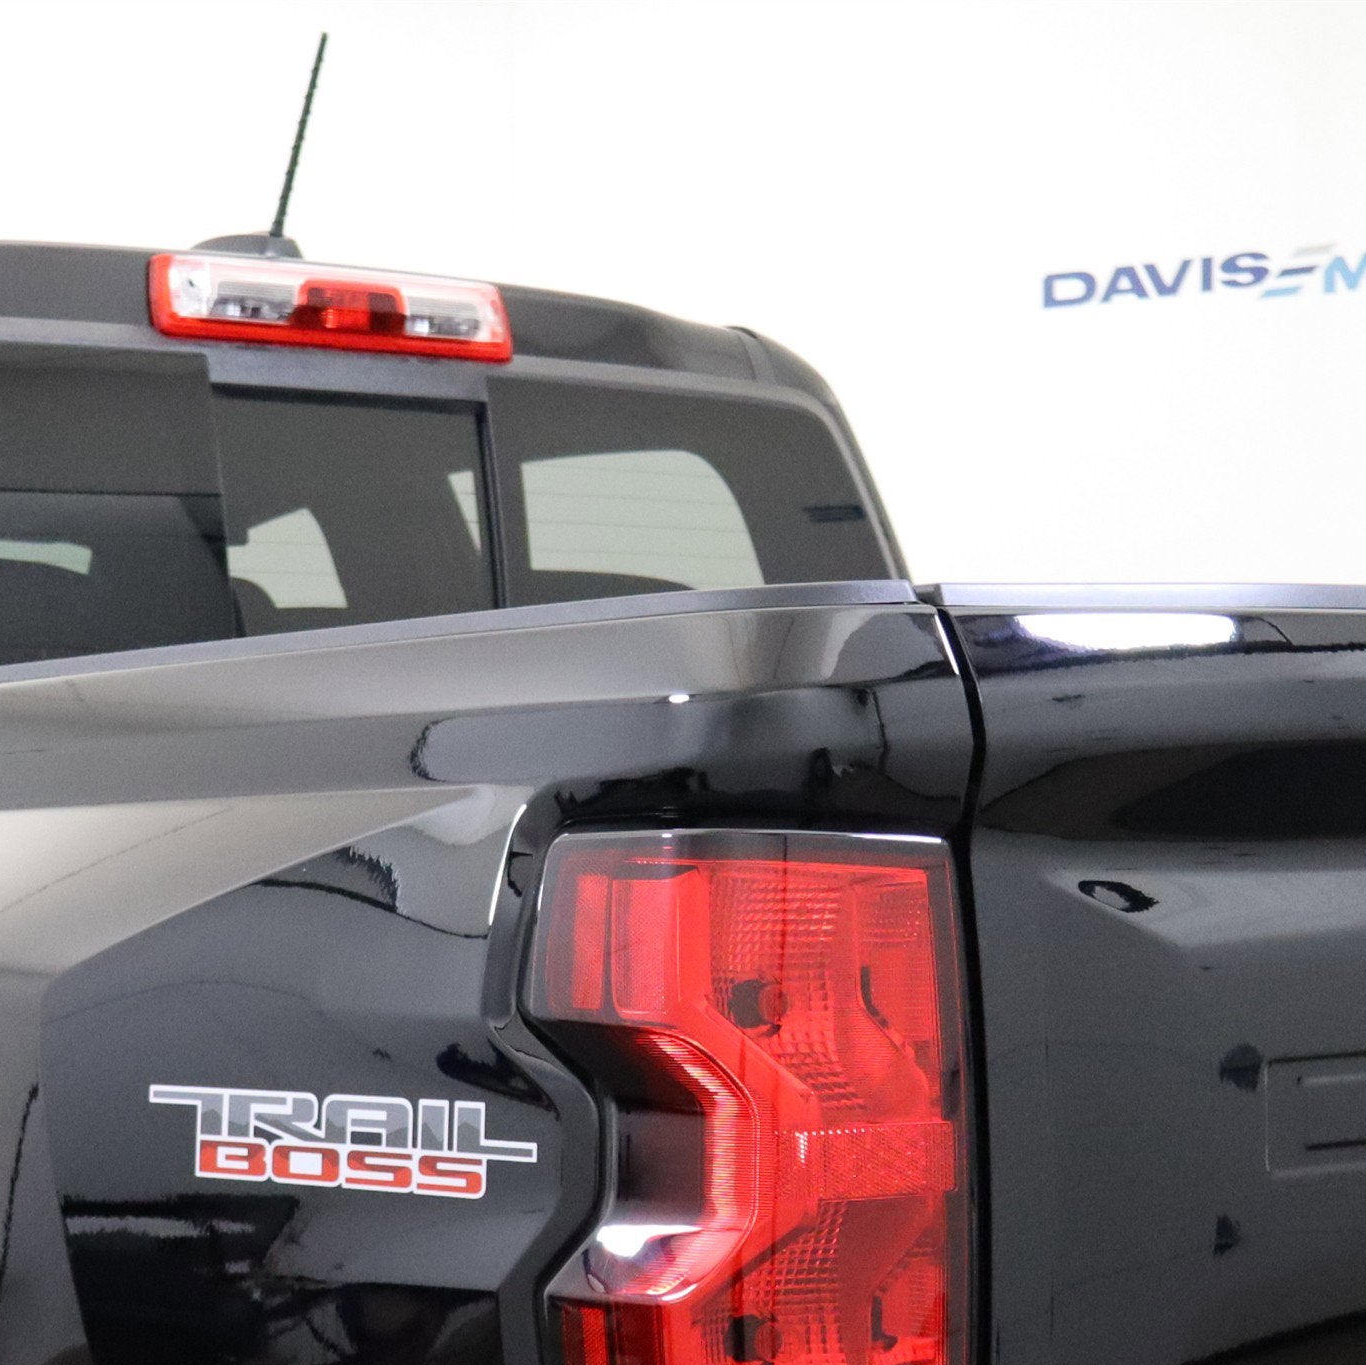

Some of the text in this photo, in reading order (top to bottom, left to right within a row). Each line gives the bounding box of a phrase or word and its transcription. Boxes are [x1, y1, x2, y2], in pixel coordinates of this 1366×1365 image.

[1043, 252, 1271, 309] DAVIS
[148, 1084, 538, 1163] TRAIL
[195, 1136, 487, 1199] BOSS
